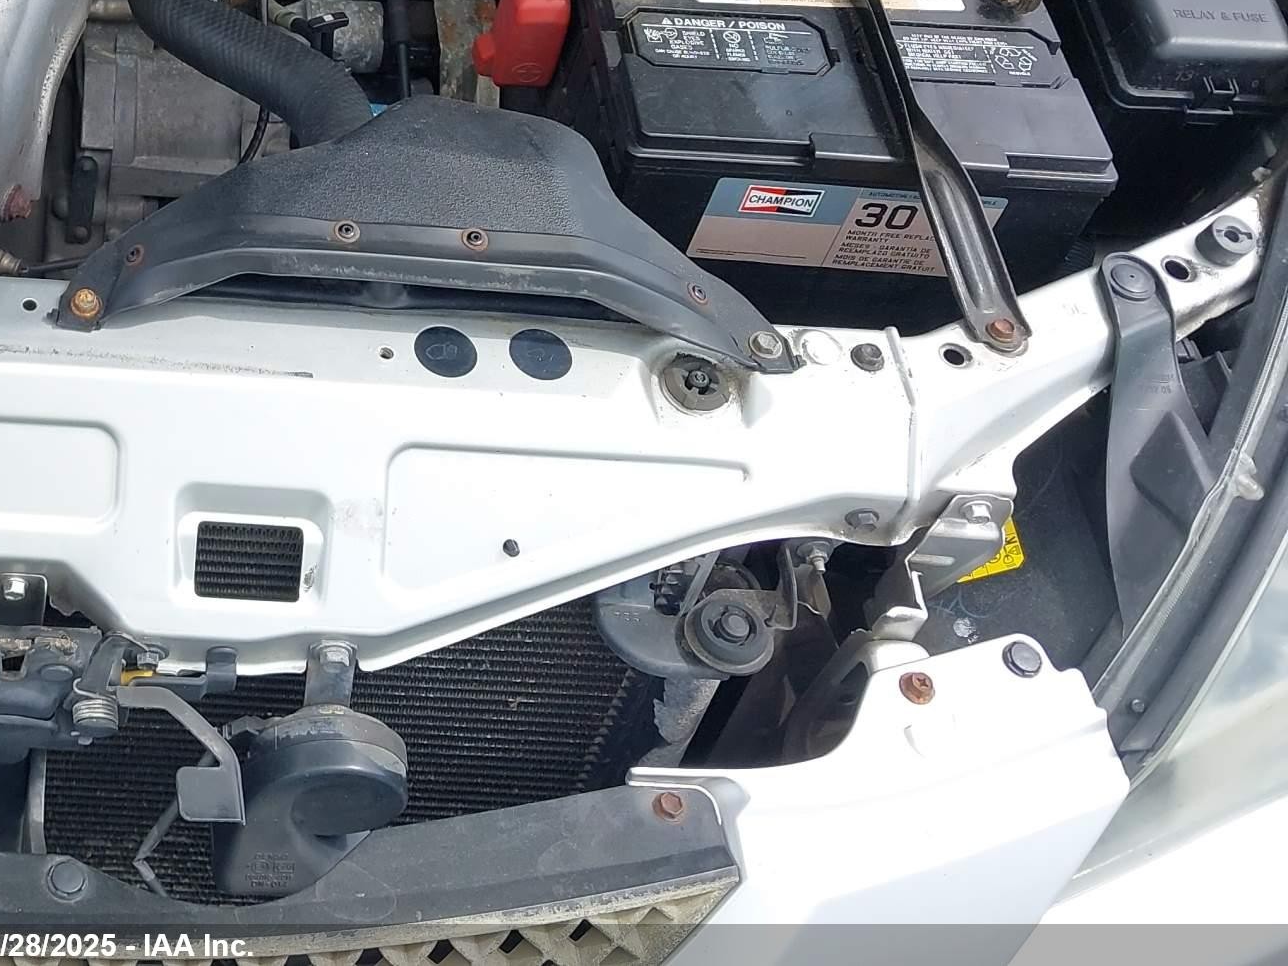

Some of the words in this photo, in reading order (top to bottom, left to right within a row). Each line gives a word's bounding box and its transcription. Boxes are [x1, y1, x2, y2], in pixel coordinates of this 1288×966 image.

[1173, 9, 1215, 20] RELAY
[1220, 11, 1231, 21] &
[1232, 11, 1272, 23] FUSE
[673, 17, 726, 28] DANGER
[739, 21, 785, 31] POISON
[748, 194, 815, 208] CHAMPION
[854, 202, 919, 230] 30
[845, 235, 889, 243] WARRANTY
[847, 229, 877, 237] MONTH
